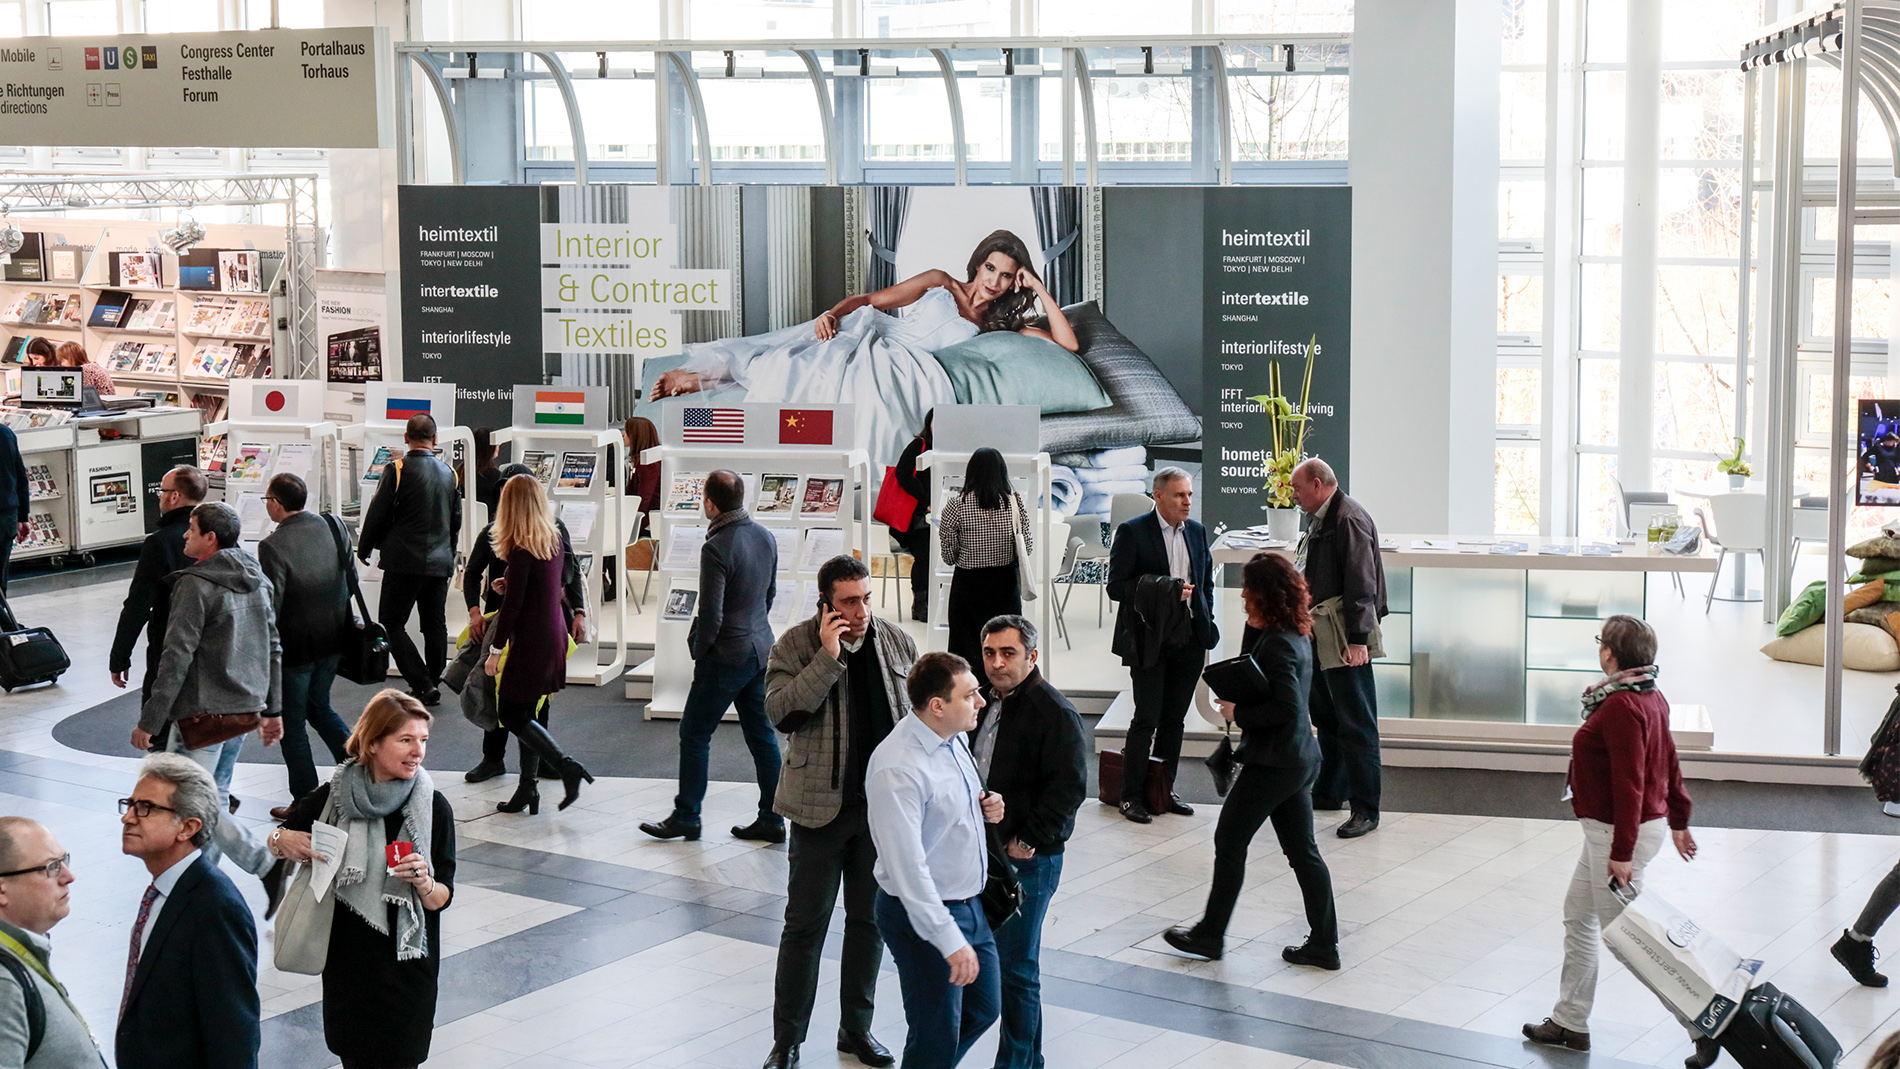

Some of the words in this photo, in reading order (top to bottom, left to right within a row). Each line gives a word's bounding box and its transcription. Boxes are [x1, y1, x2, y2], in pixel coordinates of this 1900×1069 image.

[0, 48, 36, 62] Mobile
[180, 45, 233, 60] Congress
[236, 44, 275, 58] Center
[301, 41, 365, 56] Portalhaus
[107, 51, 115, 65] U
[126, 50, 134, 65] S
[182, 66, 232, 81] Festhalle
[302, 64, 349, 79] Torhaus
[6, 84, 64, 100] Richtungen
[183, 88, 218, 102] Forum
[0, 100, 48, 114] directions
[420, 226, 498, 242] heimtextil
[1222, 229, 1310, 246] heimtextil
[557, 230, 662, 258] Interior
[420, 284, 499, 298] intertextile
[558, 274, 579, 302] &
[591, 274, 718, 304] Contract
[1222, 291, 1309, 306] intertextile
[422, 330, 511, 347] interiorlifestyle
[558, 318, 667, 348] Textiles
[1222, 340, 1322, 358] interiorlifestye
[456, 388, 495, 402] lifestyle
[498, 389, 513, 400] livi
[1222, 389, 1243, 399] IFFT
